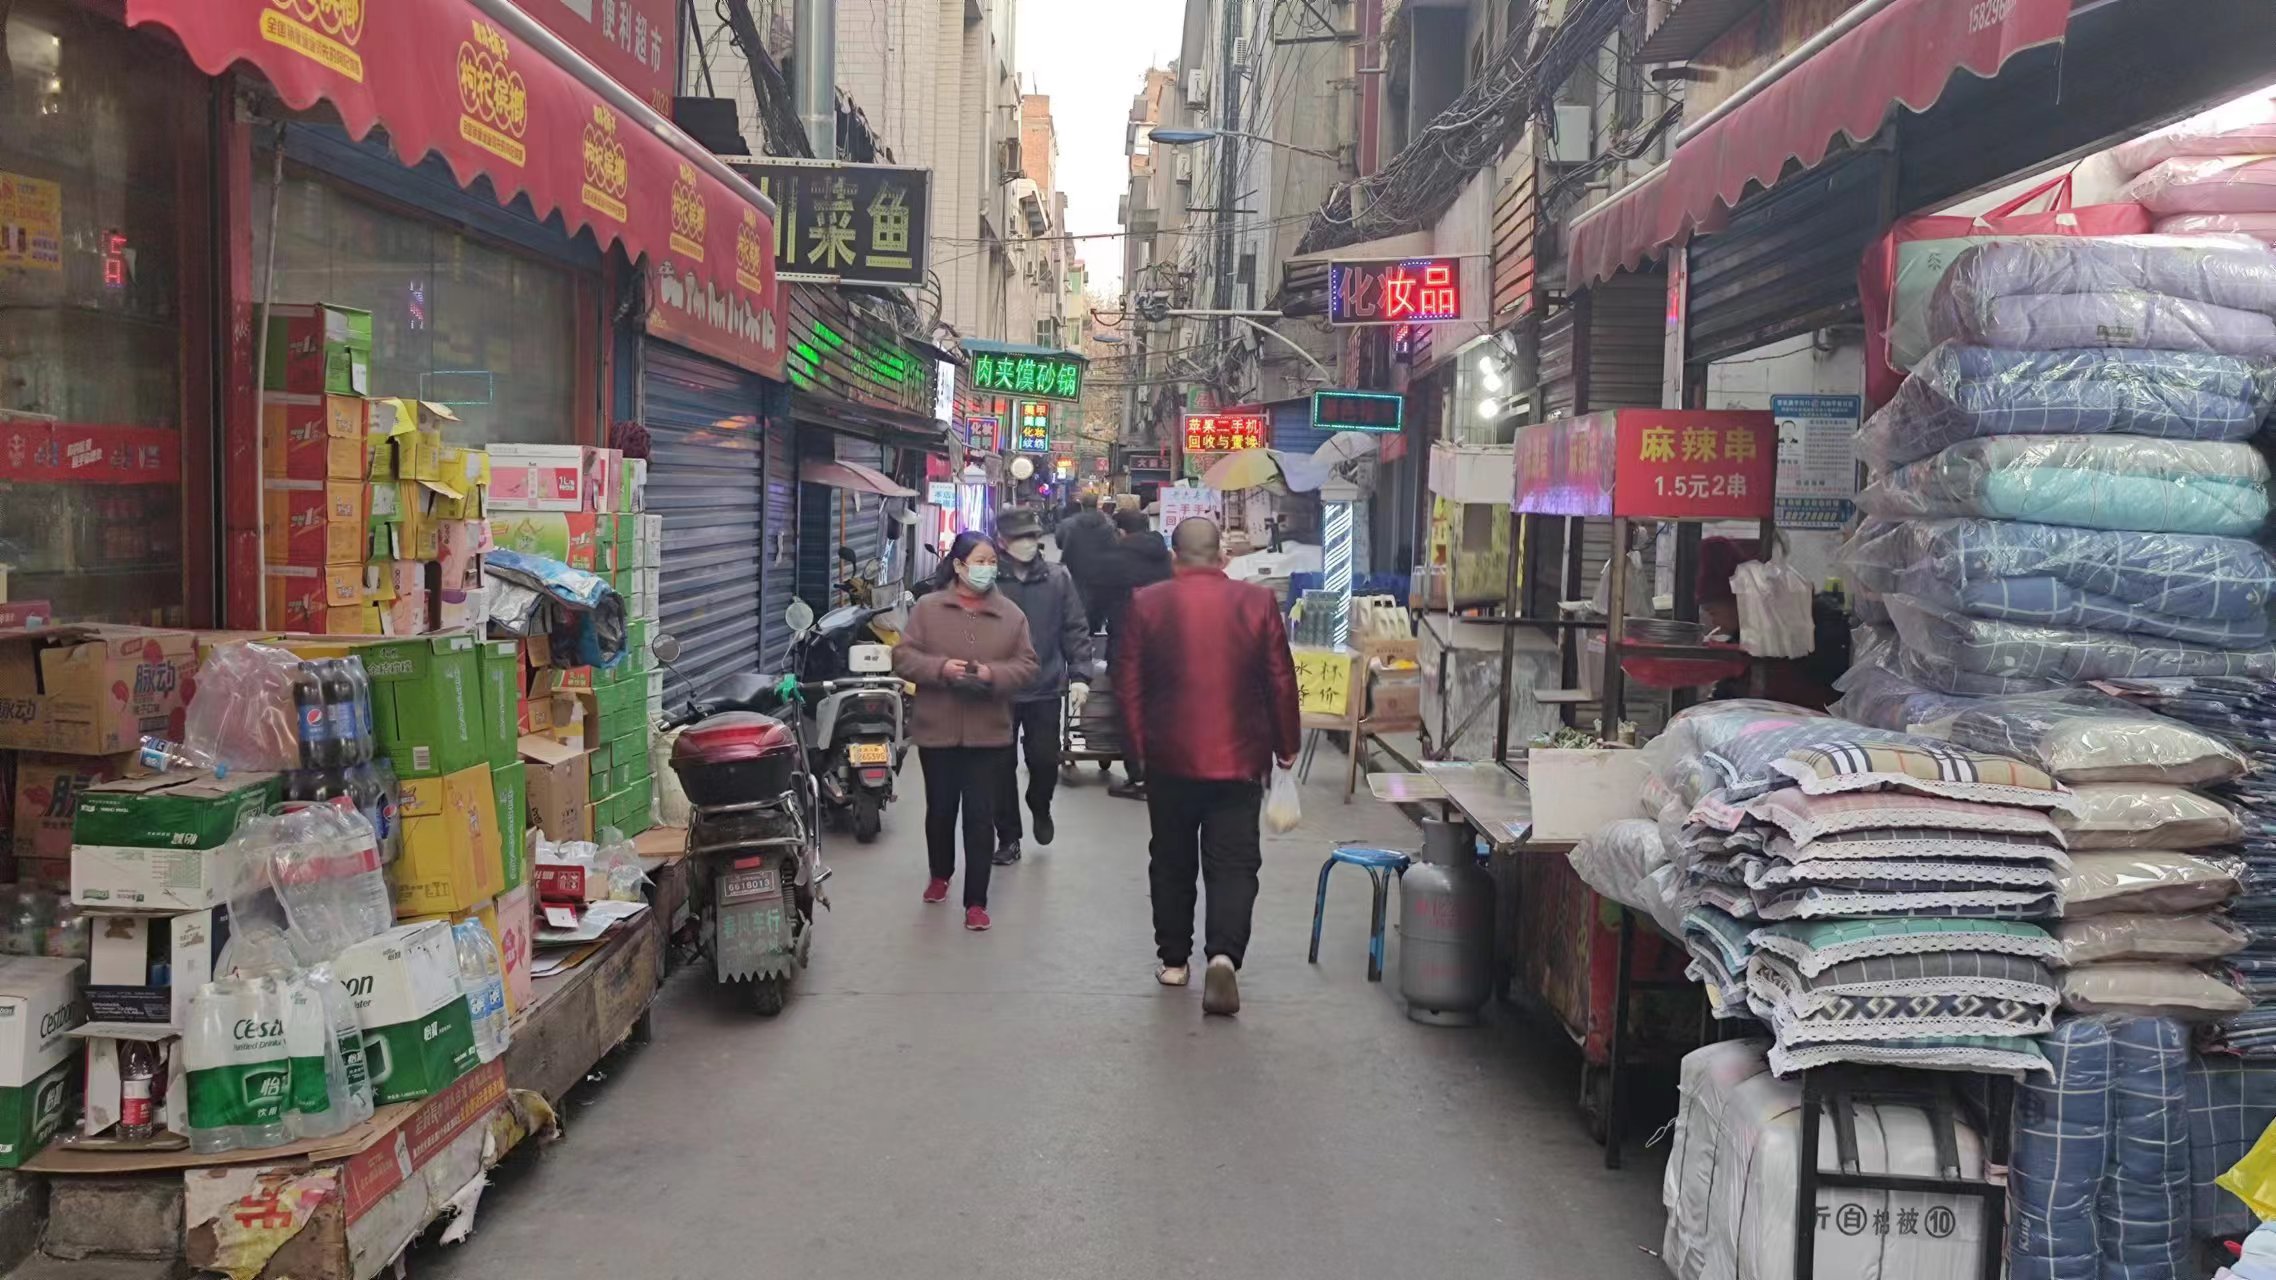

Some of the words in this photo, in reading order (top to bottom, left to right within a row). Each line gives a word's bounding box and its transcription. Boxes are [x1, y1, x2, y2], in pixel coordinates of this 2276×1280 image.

[602, 0, 662, 73] 便利超市
[460, 55, 526, 128] 枸杞槟榔
[1339, 265, 1455, 318] 化妆品
[975, 354, 1076, 397] 肉夹馍砂锅
[1188, 418, 1260, 433] 苹果二手机
[1188, 434, 1260, 450] 回收与置换
[1639, 425, 1757, 465] 麻辣串
[1655, 473, 1748, 499] 1.5元2串
[135, 659, 176, 698] 脉动
